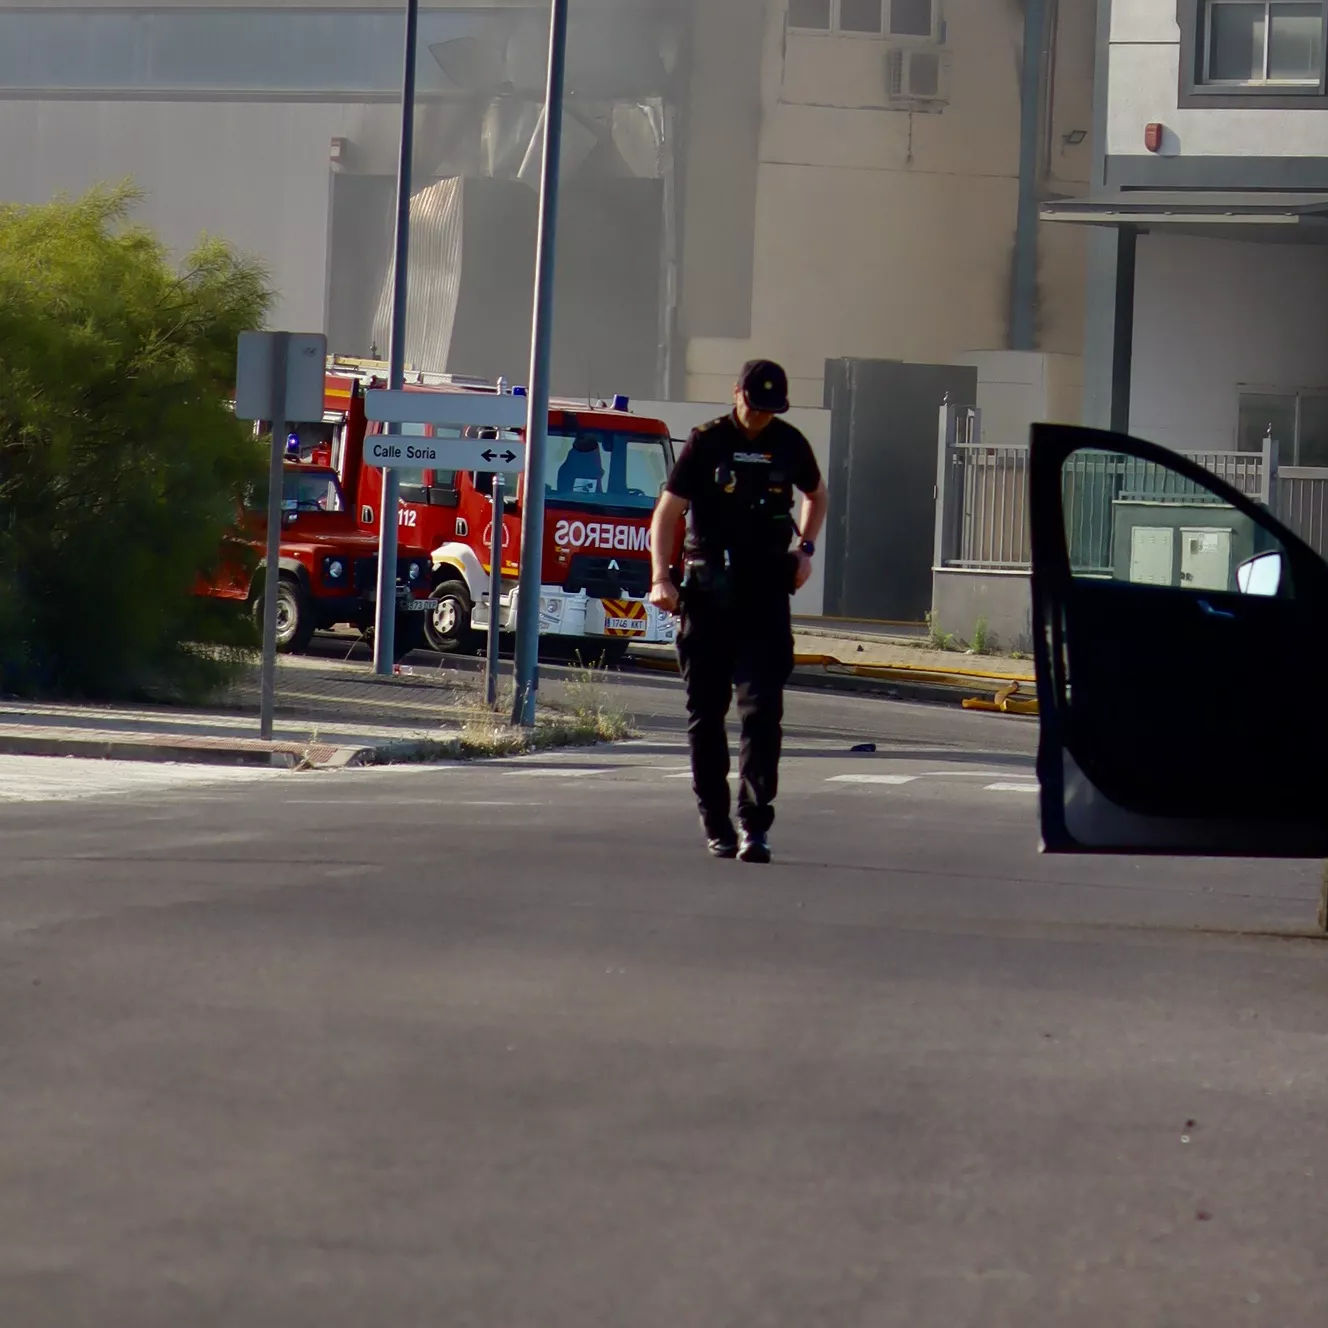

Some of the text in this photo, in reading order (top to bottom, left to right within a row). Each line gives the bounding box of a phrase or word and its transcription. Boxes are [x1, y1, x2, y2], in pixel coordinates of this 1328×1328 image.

[373, 444, 436, 460] Calle Soria
[398, 508, 417, 528] 112
